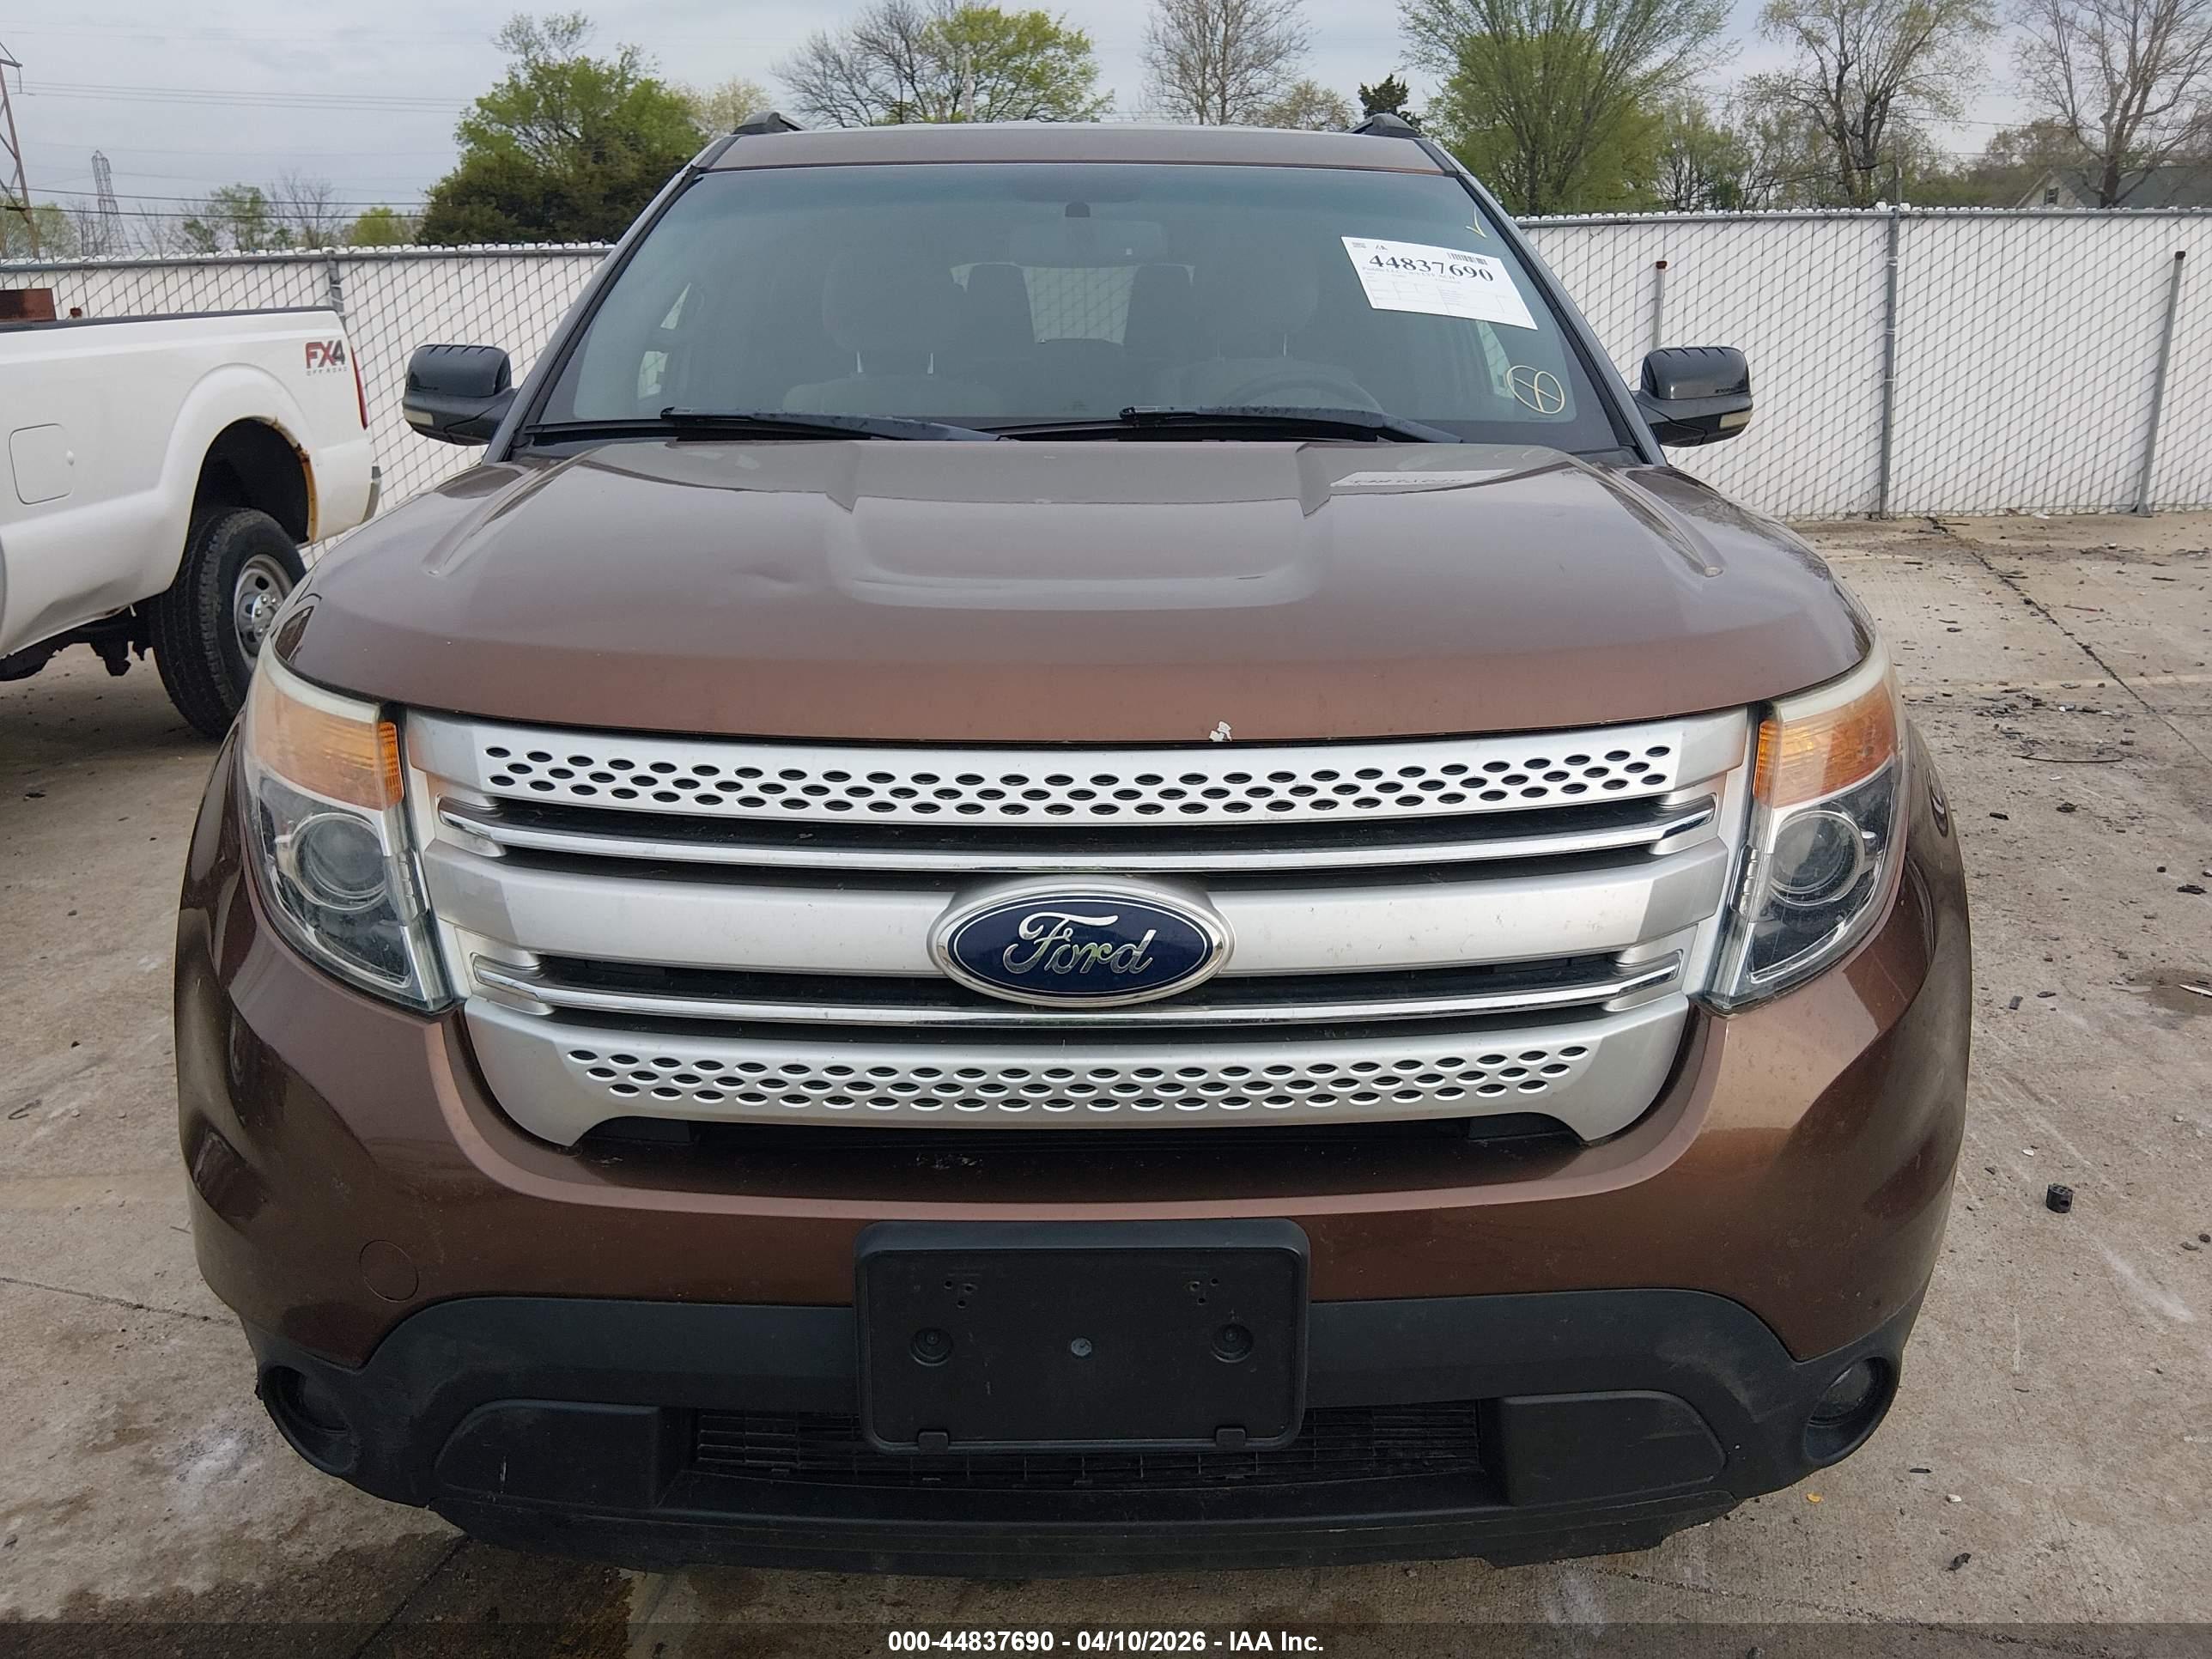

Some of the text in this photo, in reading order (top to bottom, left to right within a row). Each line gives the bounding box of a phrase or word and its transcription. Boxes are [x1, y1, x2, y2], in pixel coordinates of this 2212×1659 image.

[1369, 255, 1494, 282] 44837690
[305, 339, 346, 369] FX4
[1002, 911, 1158, 975] Ford
